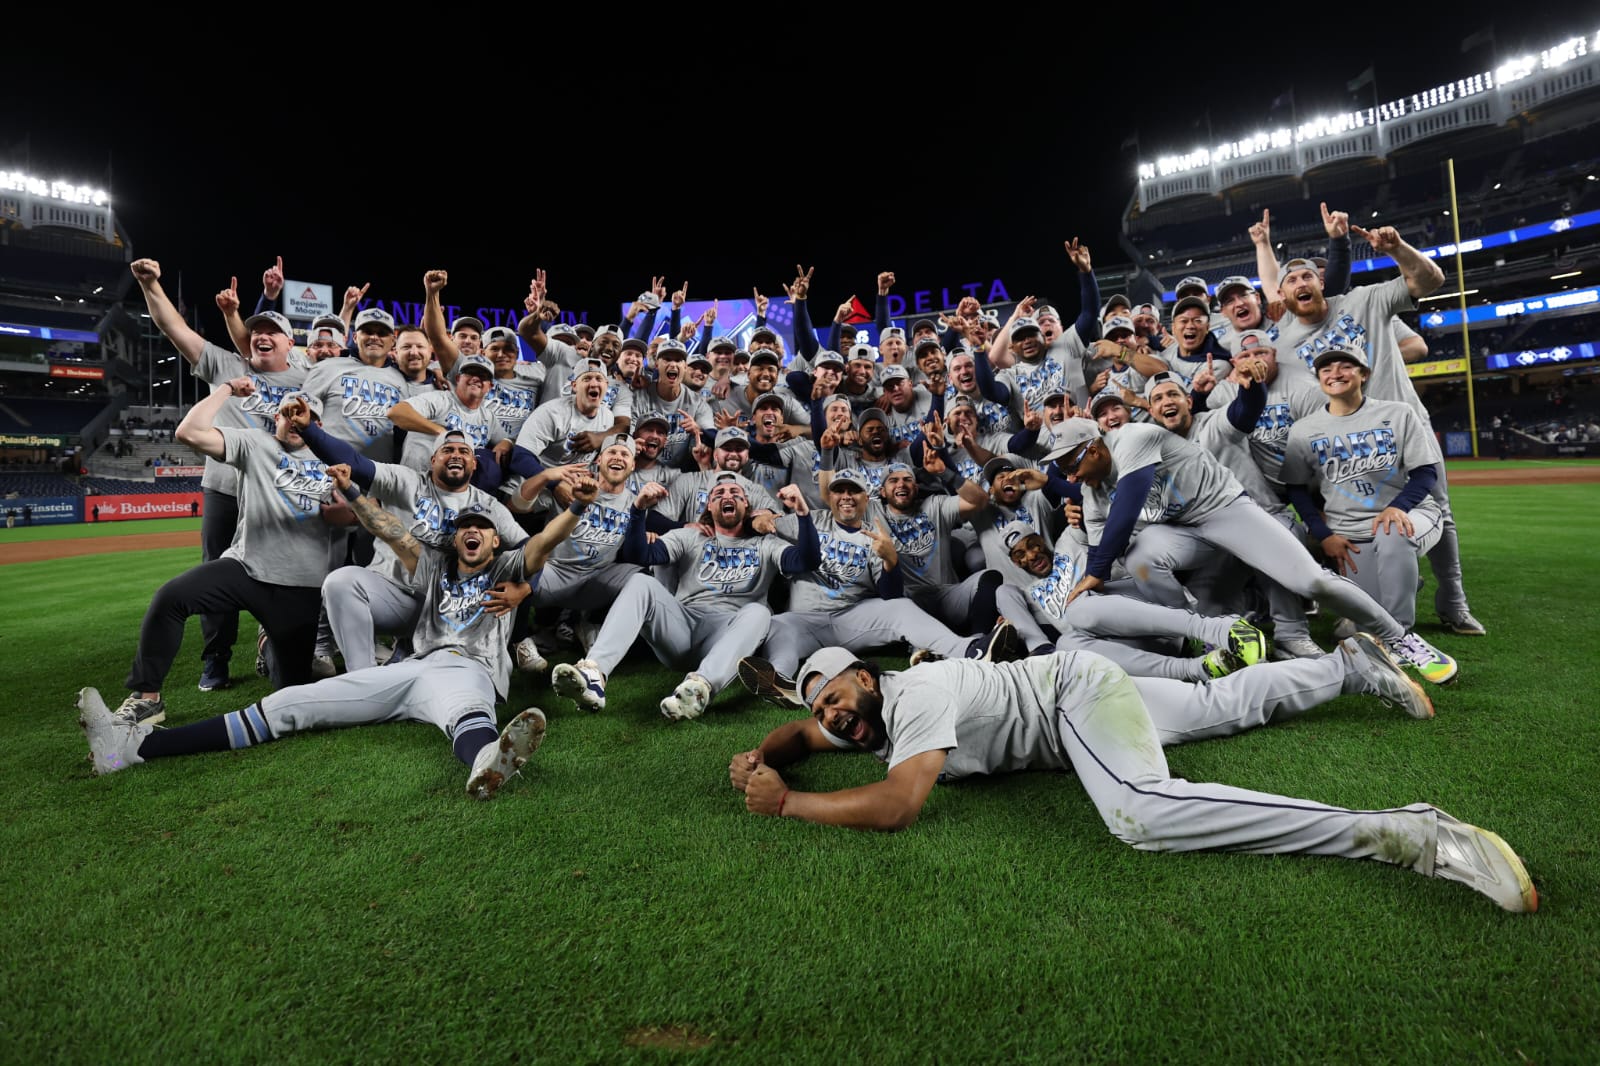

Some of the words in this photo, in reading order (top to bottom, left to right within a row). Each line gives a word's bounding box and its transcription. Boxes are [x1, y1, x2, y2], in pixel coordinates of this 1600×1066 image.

[289, 298, 329, 310] Benjamin
[888, 278, 1010, 317] DELTA
[295, 307, 322, 315] Moore
[357, 298, 461, 329] YNKE
[476, 307, 588, 331] STAM
[342, 395, 389, 419] Octob
[1255, 403, 1295, 428] KE
[363, 419, 378, 436] TB
[0, 435, 29, 444] Poland
[30, 435, 61, 447] Spring
[1311, 428, 1397, 465] TAKE
[1322, 447, 1398, 484] October
[274, 468, 333, 495] Octobe
[1350, 479, 1375, 497] TB
[120, 502, 193, 515] Budweise
[296, 493, 313, 511] TB
[414, 497, 459, 534] TAK
[580, 503, 632, 536] AKE
[703, 542, 760, 569] TAKE
[698, 560, 759, 585] October
[820, 557, 865, 582] ctober
